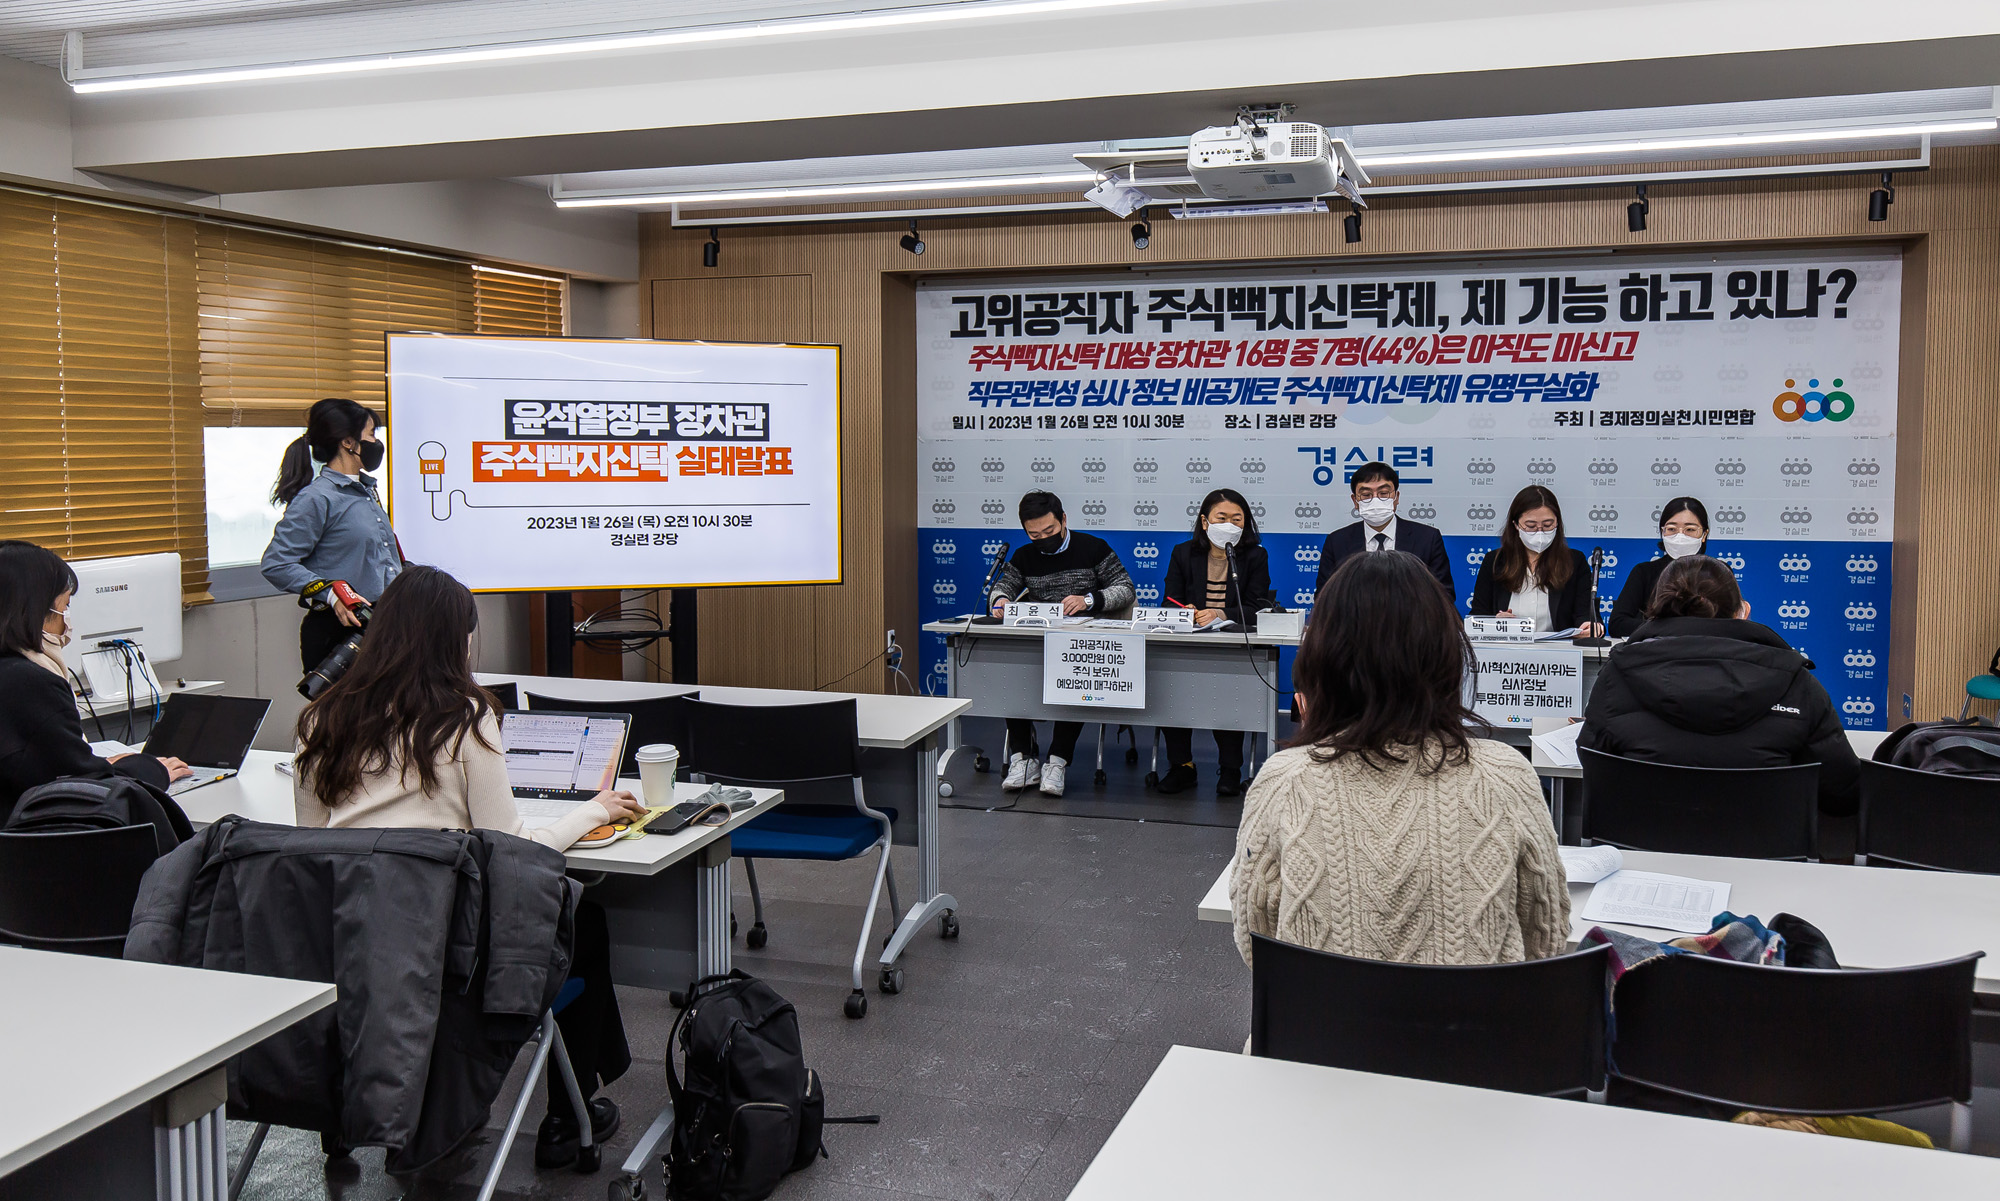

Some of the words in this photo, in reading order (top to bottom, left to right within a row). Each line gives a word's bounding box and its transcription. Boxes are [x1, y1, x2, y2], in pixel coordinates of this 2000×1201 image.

[950, 291, 1139, 338] 고위공직자
[1147, 281, 1449, 334] 주식백지신탁제,
[1460, 279, 1506, 327] 제
[1518, 276, 1608, 325] 기능
[1619, 272, 1714, 322] 하고
[1727, 268, 1857, 319] 있나?
[968, 342, 1106, 372] 주식백지신탁
[1103, 341, 1156, 370] 대상
[1155, 340, 1232, 369] 장차관
[1236, 338, 1290, 367] 16명
[1289, 338, 1320, 367] 중
[1320, 333, 1467, 367] 7명(44%)은
[1466, 333, 1552, 365] 아직도
[1551, 331, 1640, 363] 미신고
[968, 379, 1081, 408] 직무관련성
[1081, 379, 1131, 407] 심사
[1131, 378, 1182, 406] 정보
[1181, 377, 1281, 406] 비공개로
[1281, 374, 1463, 405] 주식백지신탁제
[1462, 371, 1600, 403] 유명무실화
[512, 402, 670, 436] 윤석열정부
[674, 403, 766, 437] 장차관
[952, 415, 976, 430] 일시
[988, 415, 1032, 430] 2023년
[1037, 415, 1056, 429] 1월
[1060, 415, 1089, 429] 26일
[1092, 414, 1118, 429] 오전
[1122, 414, 1150, 429] 10시
[1154, 414, 1185, 428] 30분
[1224, 414, 1256, 429] 장소
[1265, 414, 1305, 429] 경실련
[1309, 413, 1337, 428] 강당
[1554, 411, 1584, 427] 주최
[1599, 408, 1756, 427] 경제정의실천시민연합
[425, 463, 439, 471] LIVE
[480, 443, 668, 478] 주식백지신탁
[675, 445, 794, 477] 실태발표
[527, 516, 578, 529] 2023년
[581, 516, 600, 529] 1월
[603, 516, 634, 529] 26일
[637, 515, 661, 529] (목)
[664, 515, 689, 528] 오전
[692, 515, 720, 528] 10시
[723, 514, 753, 527] 30분
[610, 533, 649, 546] 경실련
[652, 532, 679, 546] 강당
[95, 584, 128, 594] SAMSUNG
[1069, 639, 1123, 652] 고위공직자는
[1108, 654, 1126, 665] 이상
[1072, 665, 1091, 677] 주식
[1093, 666, 1120, 678] 보유시
[1056, 678, 1092, 690] 예외없이
[1094, 680, 1133, 692] 매각하라!
[1501, 678, 1547, 692] 심사정보
[1476, 693, 1521, 707] 투명하게
[1523, 694, 1572, 708] 공개하라!
